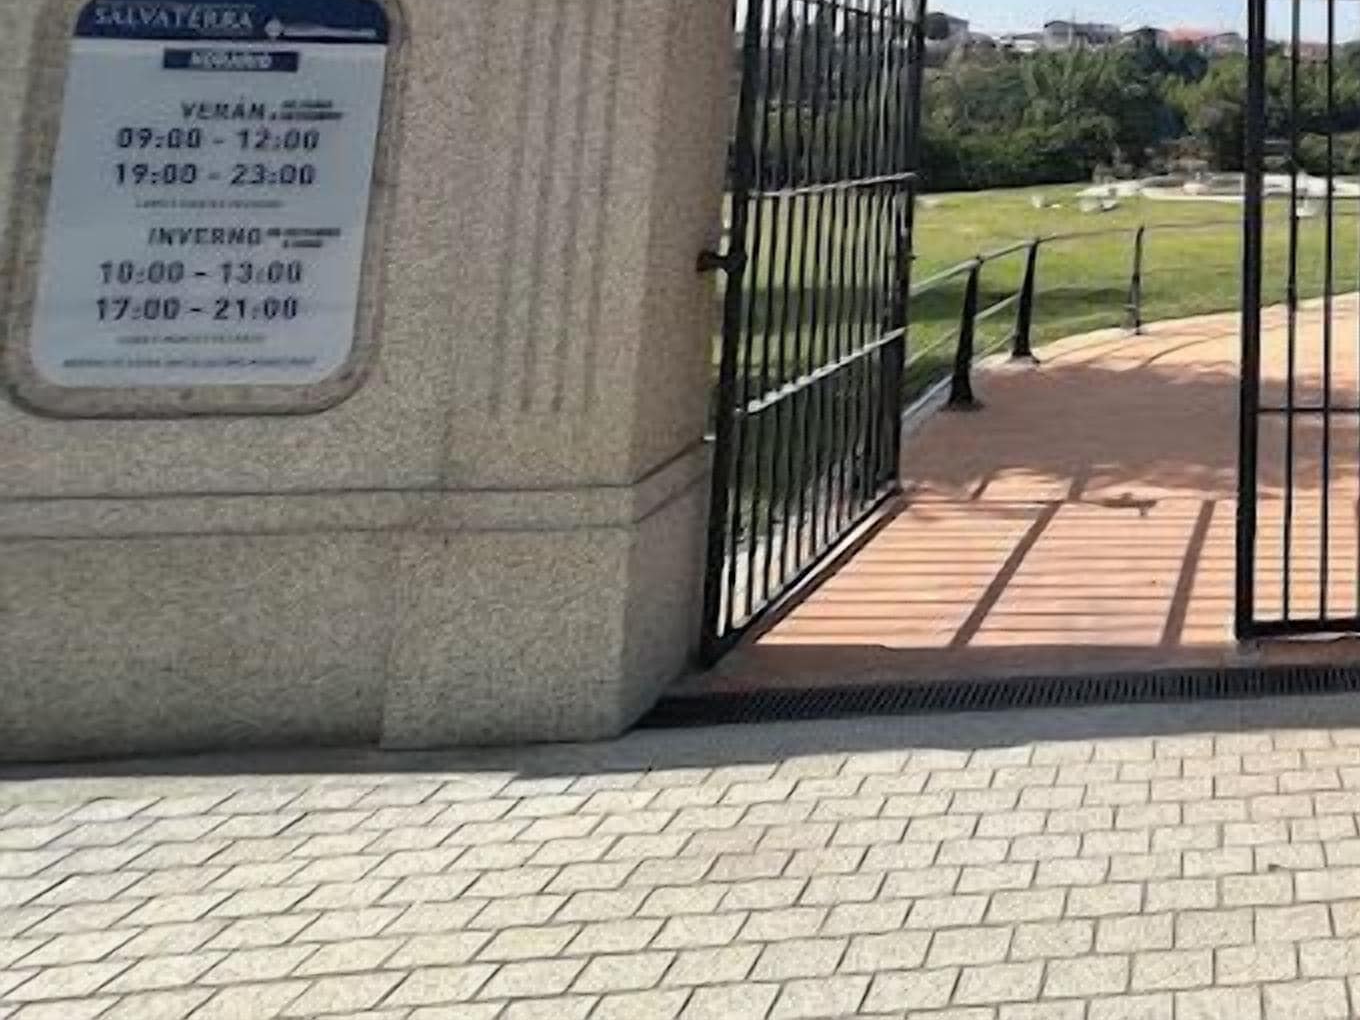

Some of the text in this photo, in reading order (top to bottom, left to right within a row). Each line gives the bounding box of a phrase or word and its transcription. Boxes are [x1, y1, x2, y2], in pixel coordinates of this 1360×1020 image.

[117, 127, 201, 149] 09:00
[237, 129, 320, 150] 12:00
[116, 163, 197, 186] 19:00
[230, 163, 315, 186] 23:00
[148, 228, 263, 246] INVERNO
[101, 260, 185, 284] 10:00
[221, 260, 303, 284] 13:00
[96, 296, 181, 321] 17:00
[213, 297, 299, 321] 21:00
